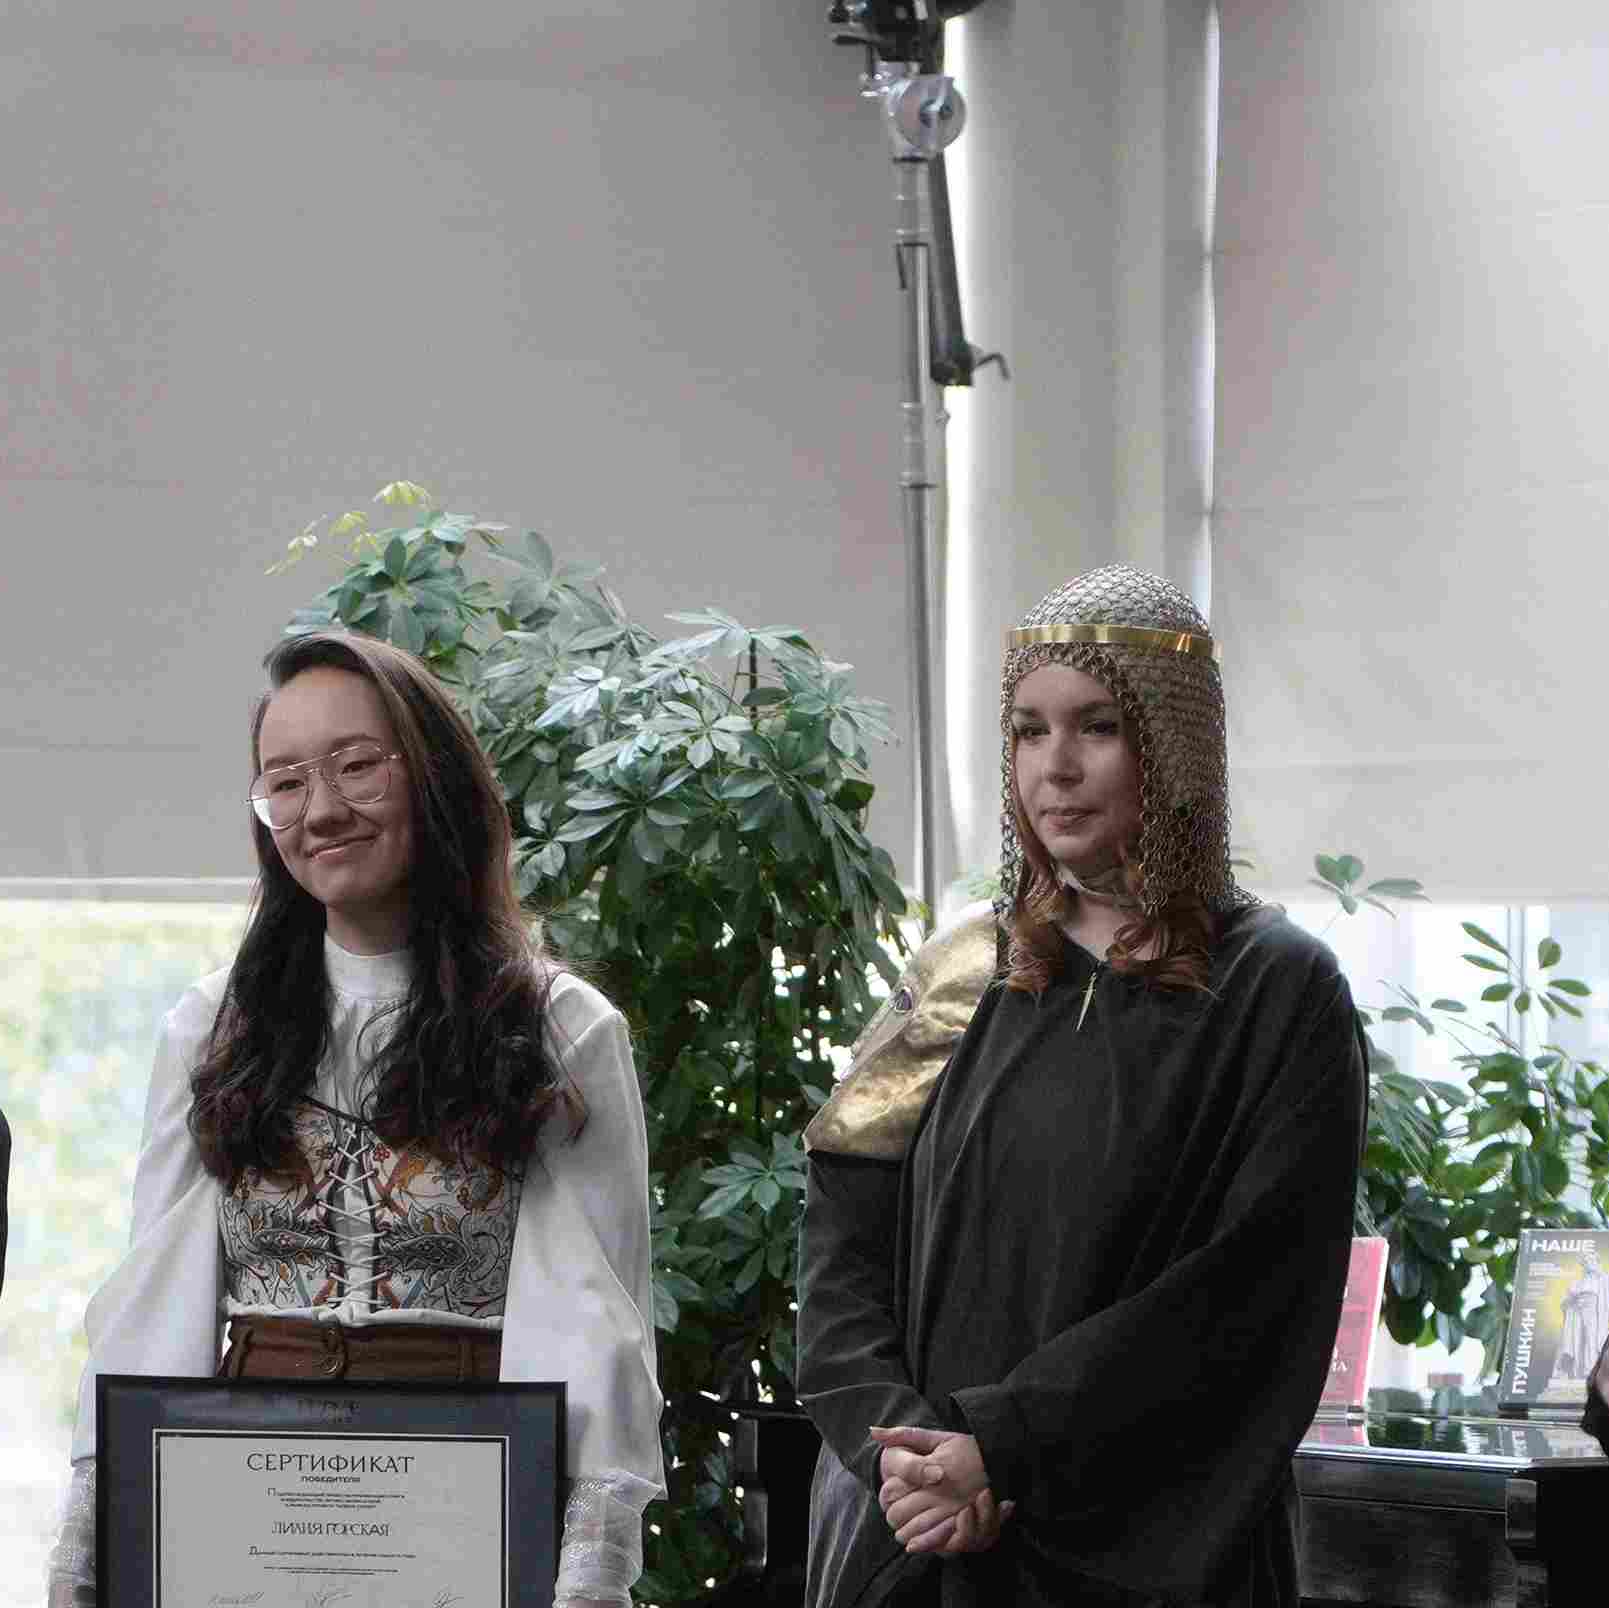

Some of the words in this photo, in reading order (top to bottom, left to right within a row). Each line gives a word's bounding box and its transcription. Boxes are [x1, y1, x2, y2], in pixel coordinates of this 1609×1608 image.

[1532, 1239, 1596, 1251] НАШЕ
[1511, 1308, 1537, 1394] ПУШКИН
[247, 1453, 415, 1473] СЕРТИФИКАТ
